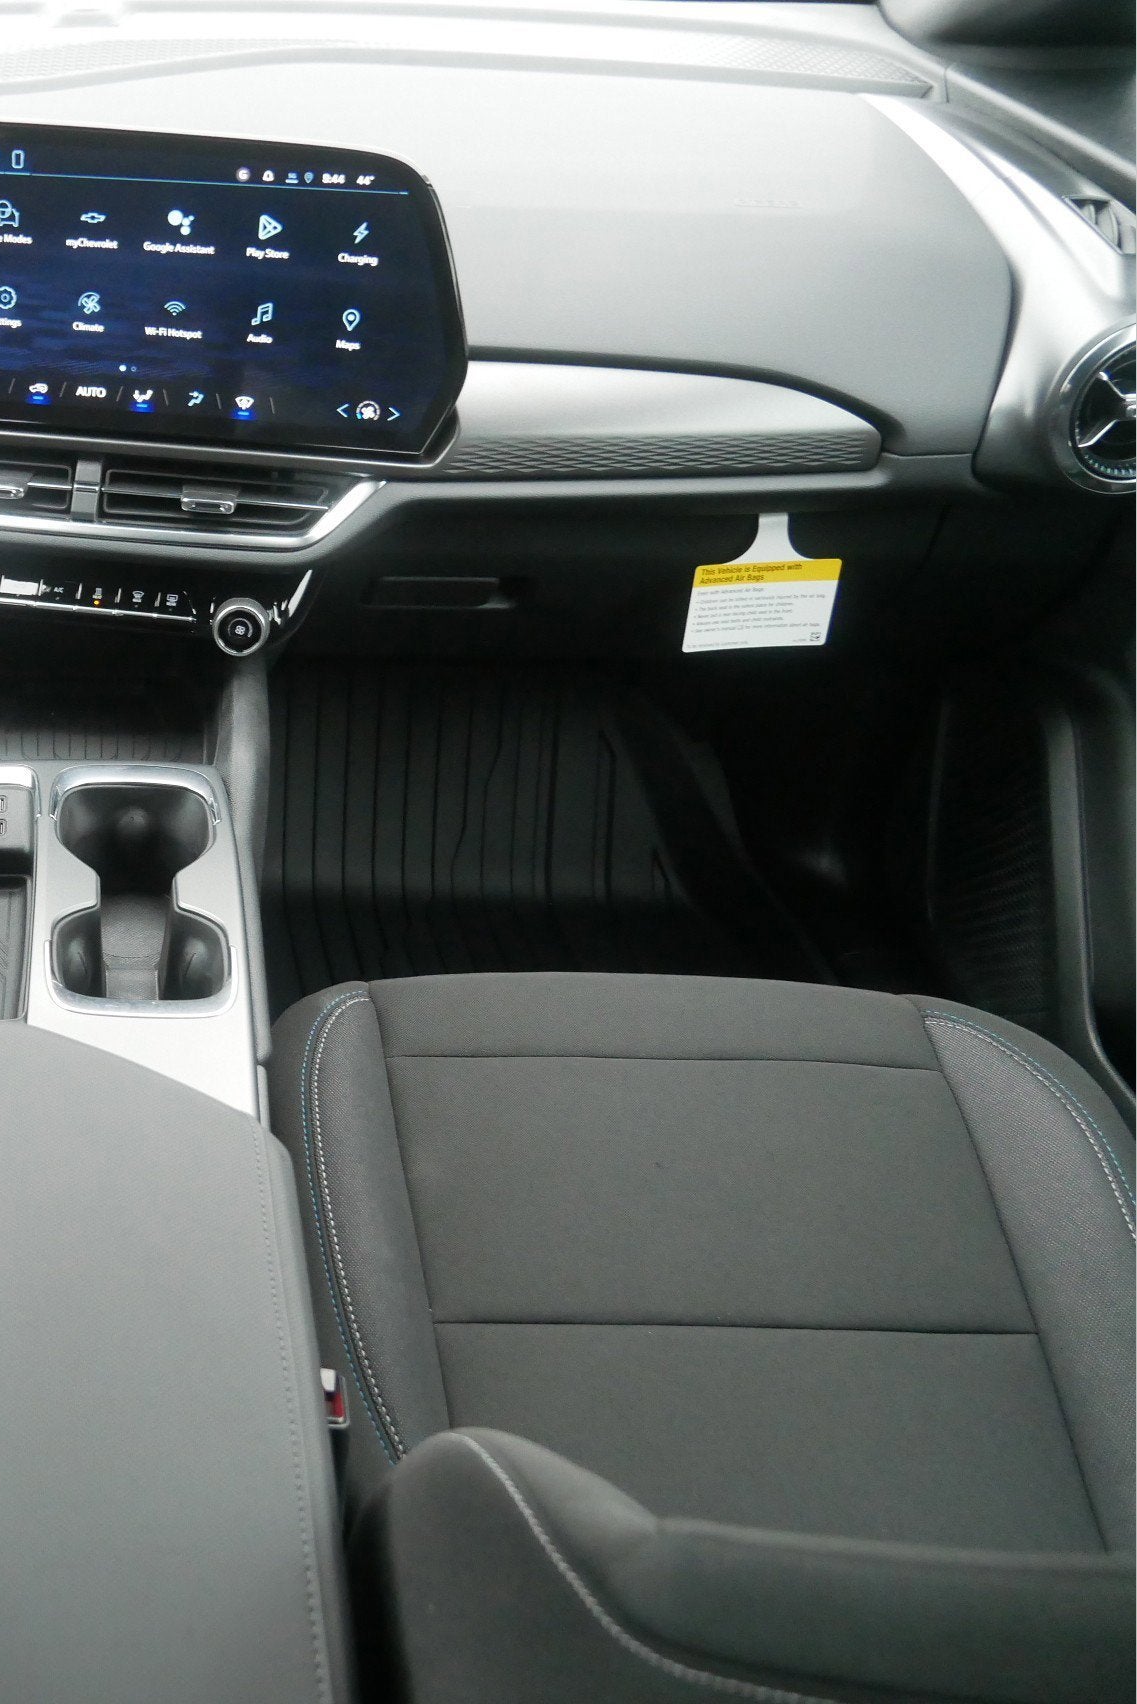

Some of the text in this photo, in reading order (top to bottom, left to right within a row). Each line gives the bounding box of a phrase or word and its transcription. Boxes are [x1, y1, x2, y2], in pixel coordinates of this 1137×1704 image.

[4, 233, 33, 245] Modes
[65, 237, 119, 250] myChevrolet
[143, 241, 215, 255] Google Assistant
[246, 247, 290, 260] Play Store
[337, 252, 379, 267] Charging
[72, 321, 105, 333] Climate
[144, 326, 203, 341] Wi-Fi Hotspot
[247, 333, 273, 344] Audio
[335, 339, 361, 351] Maps
[75, 385, 107, 398] AUTO
[701, 563, 803, 576] This Vehicle is Equipped with
[700, 573, 764, 585] Advanced Air Bags
